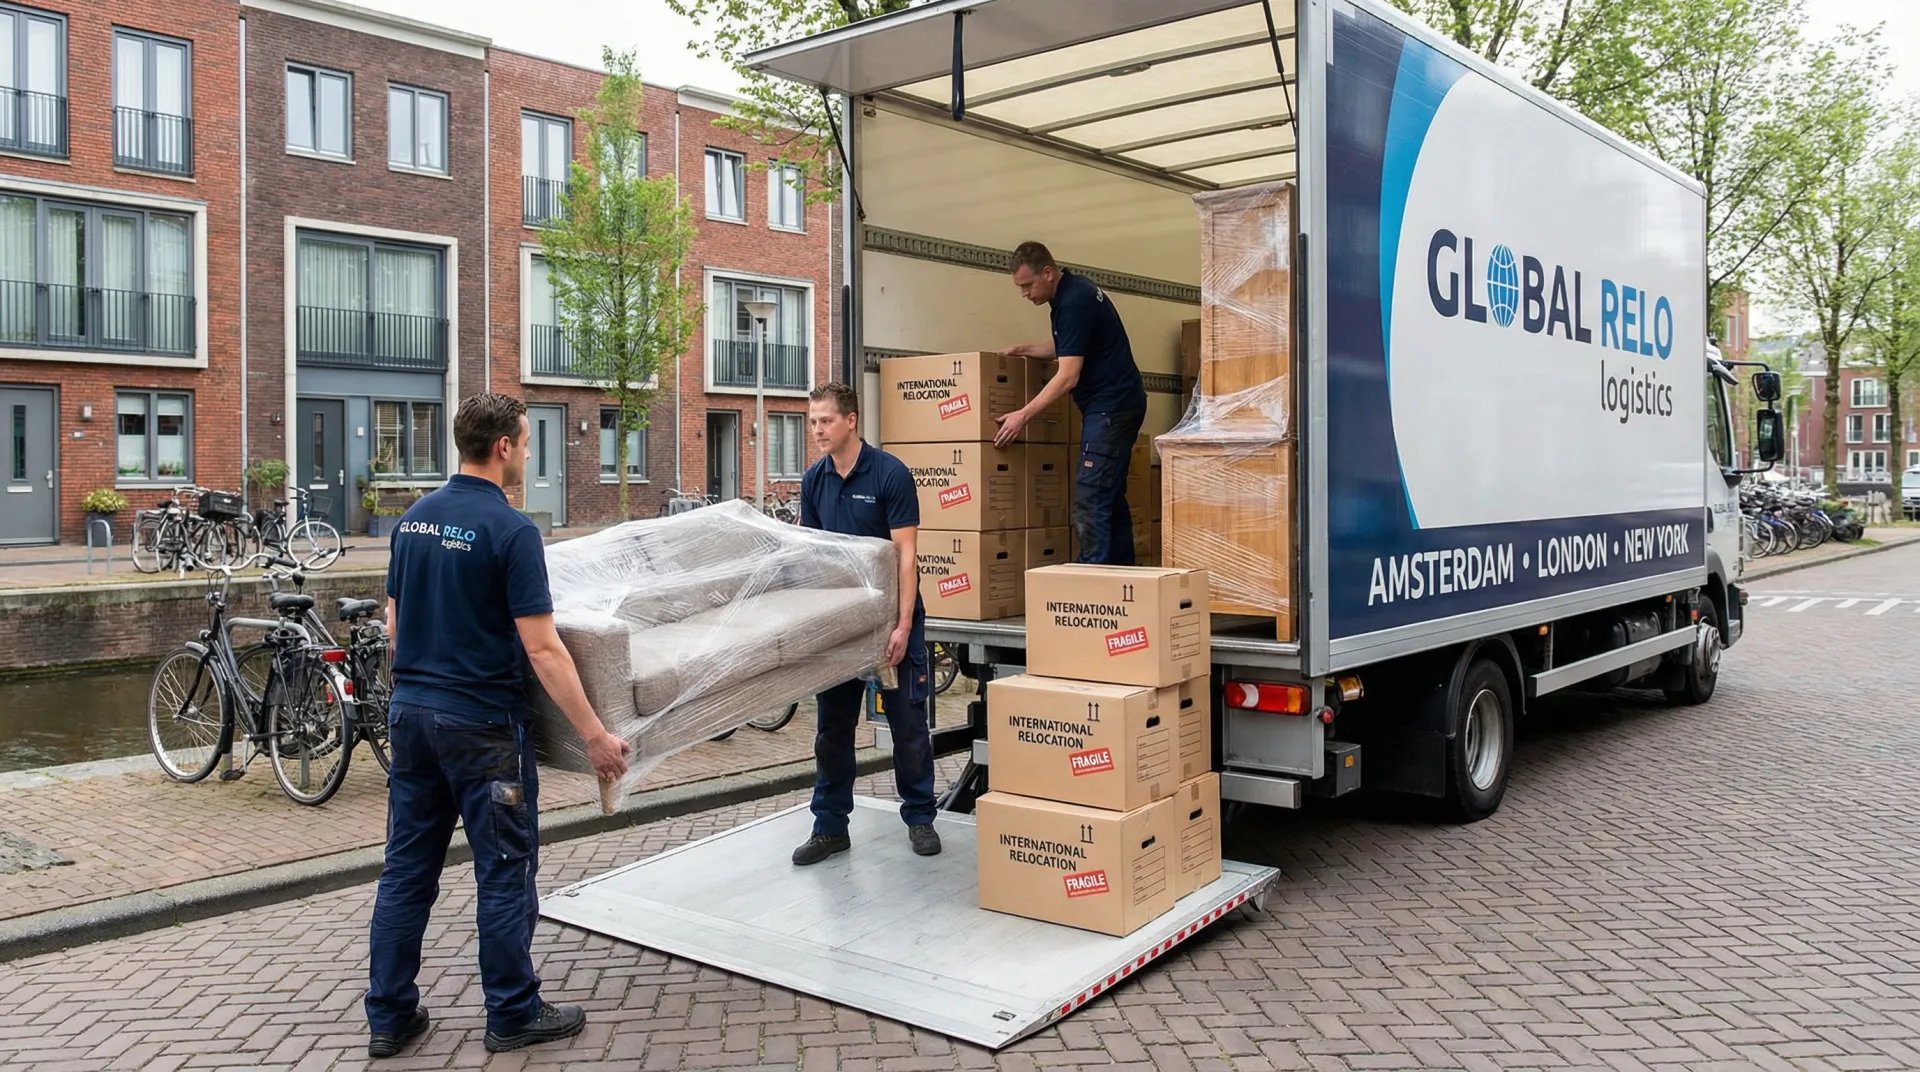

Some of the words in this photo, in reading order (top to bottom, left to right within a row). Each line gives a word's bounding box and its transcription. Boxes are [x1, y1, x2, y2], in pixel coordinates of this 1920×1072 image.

[1601, 279, 1673, 360] RELO
[897, 378, 957, 390] INTERNATIONAL
[1601, 359, 1673, 424] logistics
[903, 389, 950, 400] RELOCATION
[915, 478, 949, 487] OCATION
[400, 521, 440, 536] GLOBAL
[443, 525, 476, 542] RELO
[916, 554, 956, 565] NATIONAL
[1368, 543, 1514, 606] AMSTERDAM
[1538, 533, 1607, 577] LONDON
[1625, 527, 1655, 564] NEW
[1656, 523, 1689, 558] YORK
[1046, 602, 1128, 617] INTERNATIONAL
[1055, 616, 1118, 630] RELOCATION
[1108, 631, 1145, 650] FRAGILE
[1009, 715, 1094, 736] INTERNATIONAL
[1018, 730, 1083, 749] RELOCATION
[1072, 751, 1110, 769] FRAGILE
[1000, 833, 1087, 859] INTERNATIONAL
[1010, 849, 1076, 872] RELOCATION
[1066, 873, 1105, 891] FRAGILE
